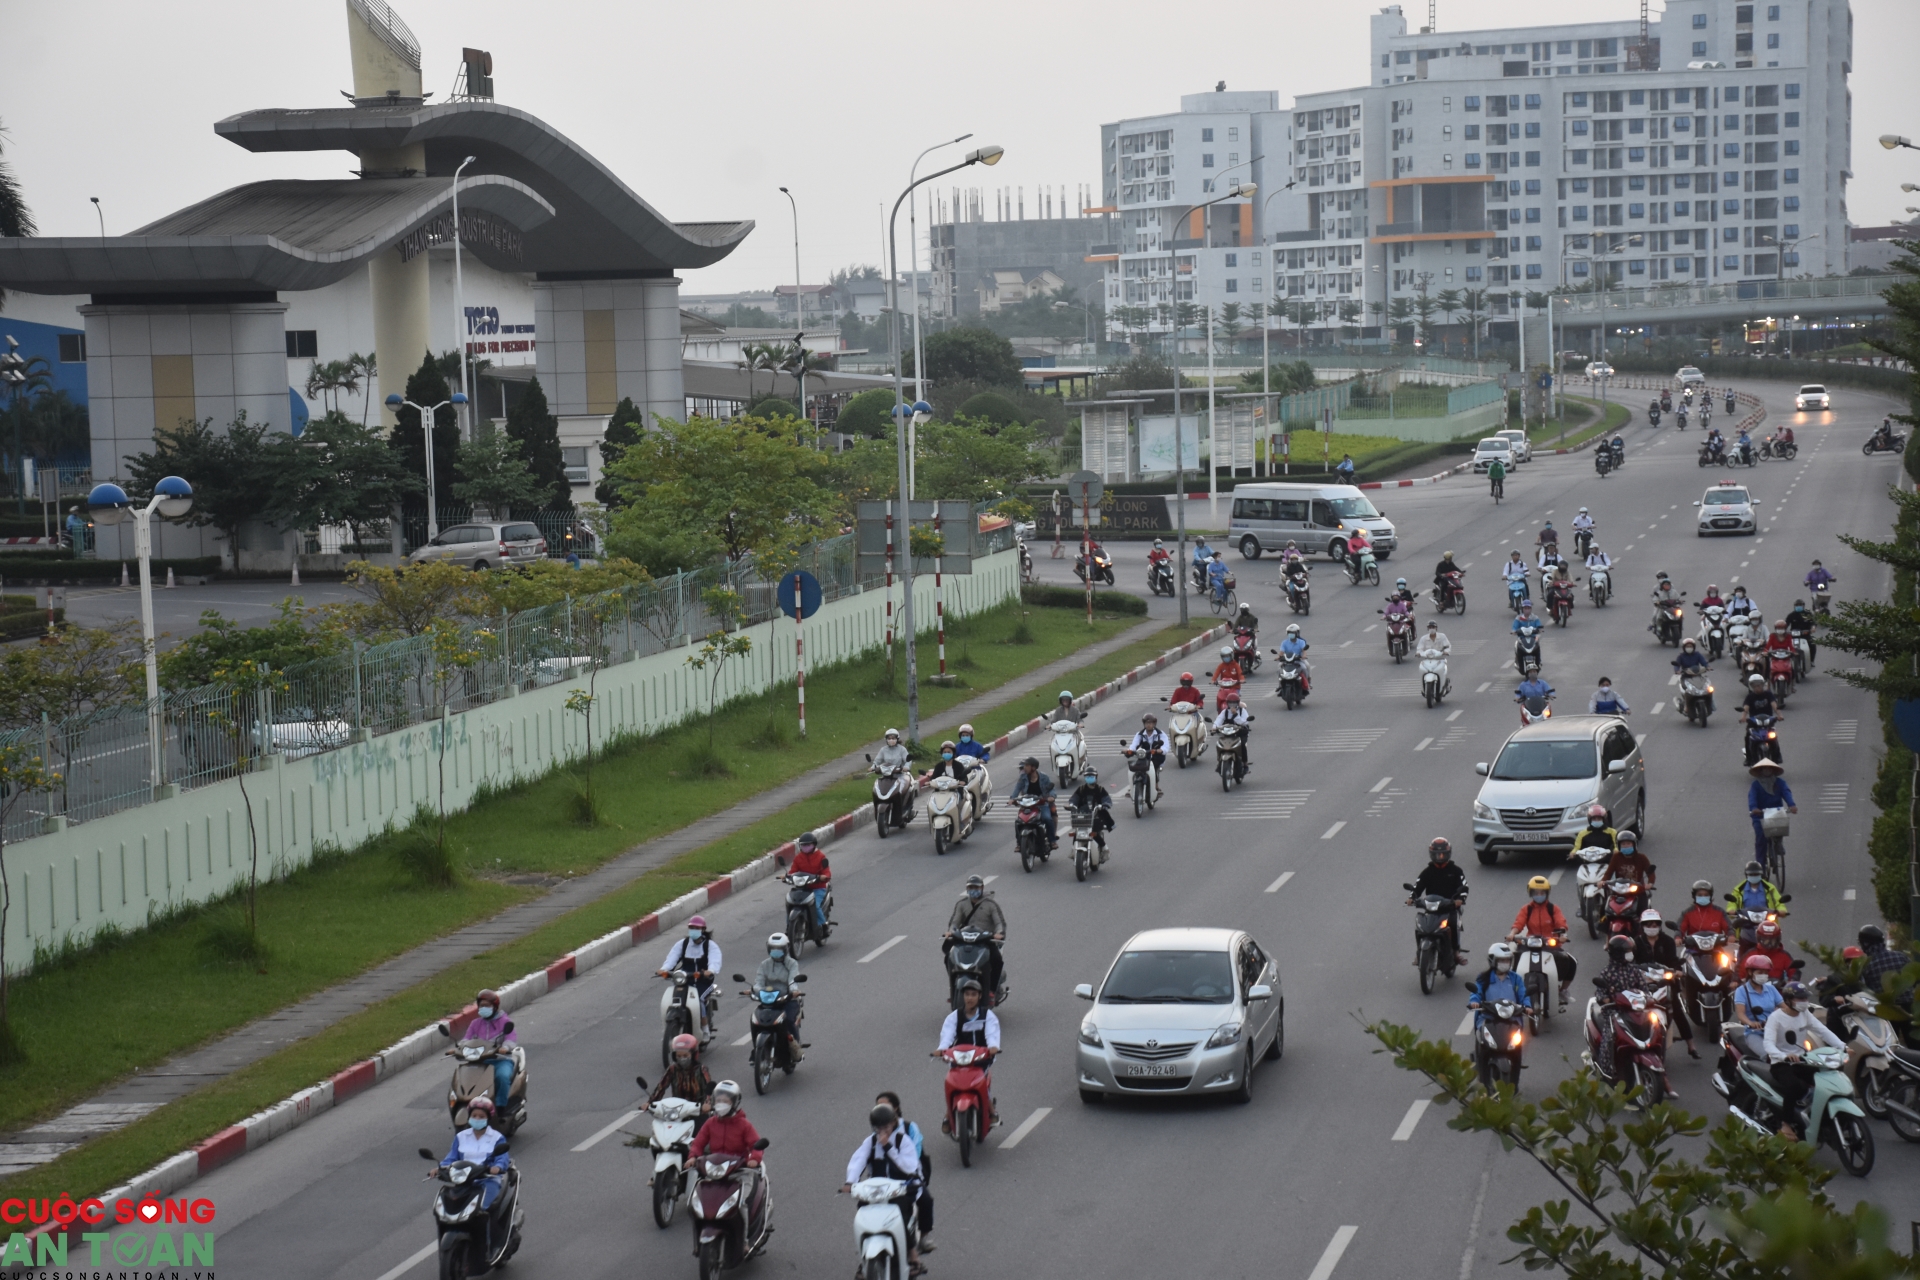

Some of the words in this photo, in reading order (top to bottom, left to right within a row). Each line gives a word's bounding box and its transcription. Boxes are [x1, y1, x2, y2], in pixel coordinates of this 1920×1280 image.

[402, 225, 430, 263] THANG
[433, 217, 455, 246] LONG
[503, 227, 523, 263] PARK
[464, 306, 500, 335] TOHO
[1116, 502, 1147, 511] LONG
[1124, 517, 1159, 529] PARK
